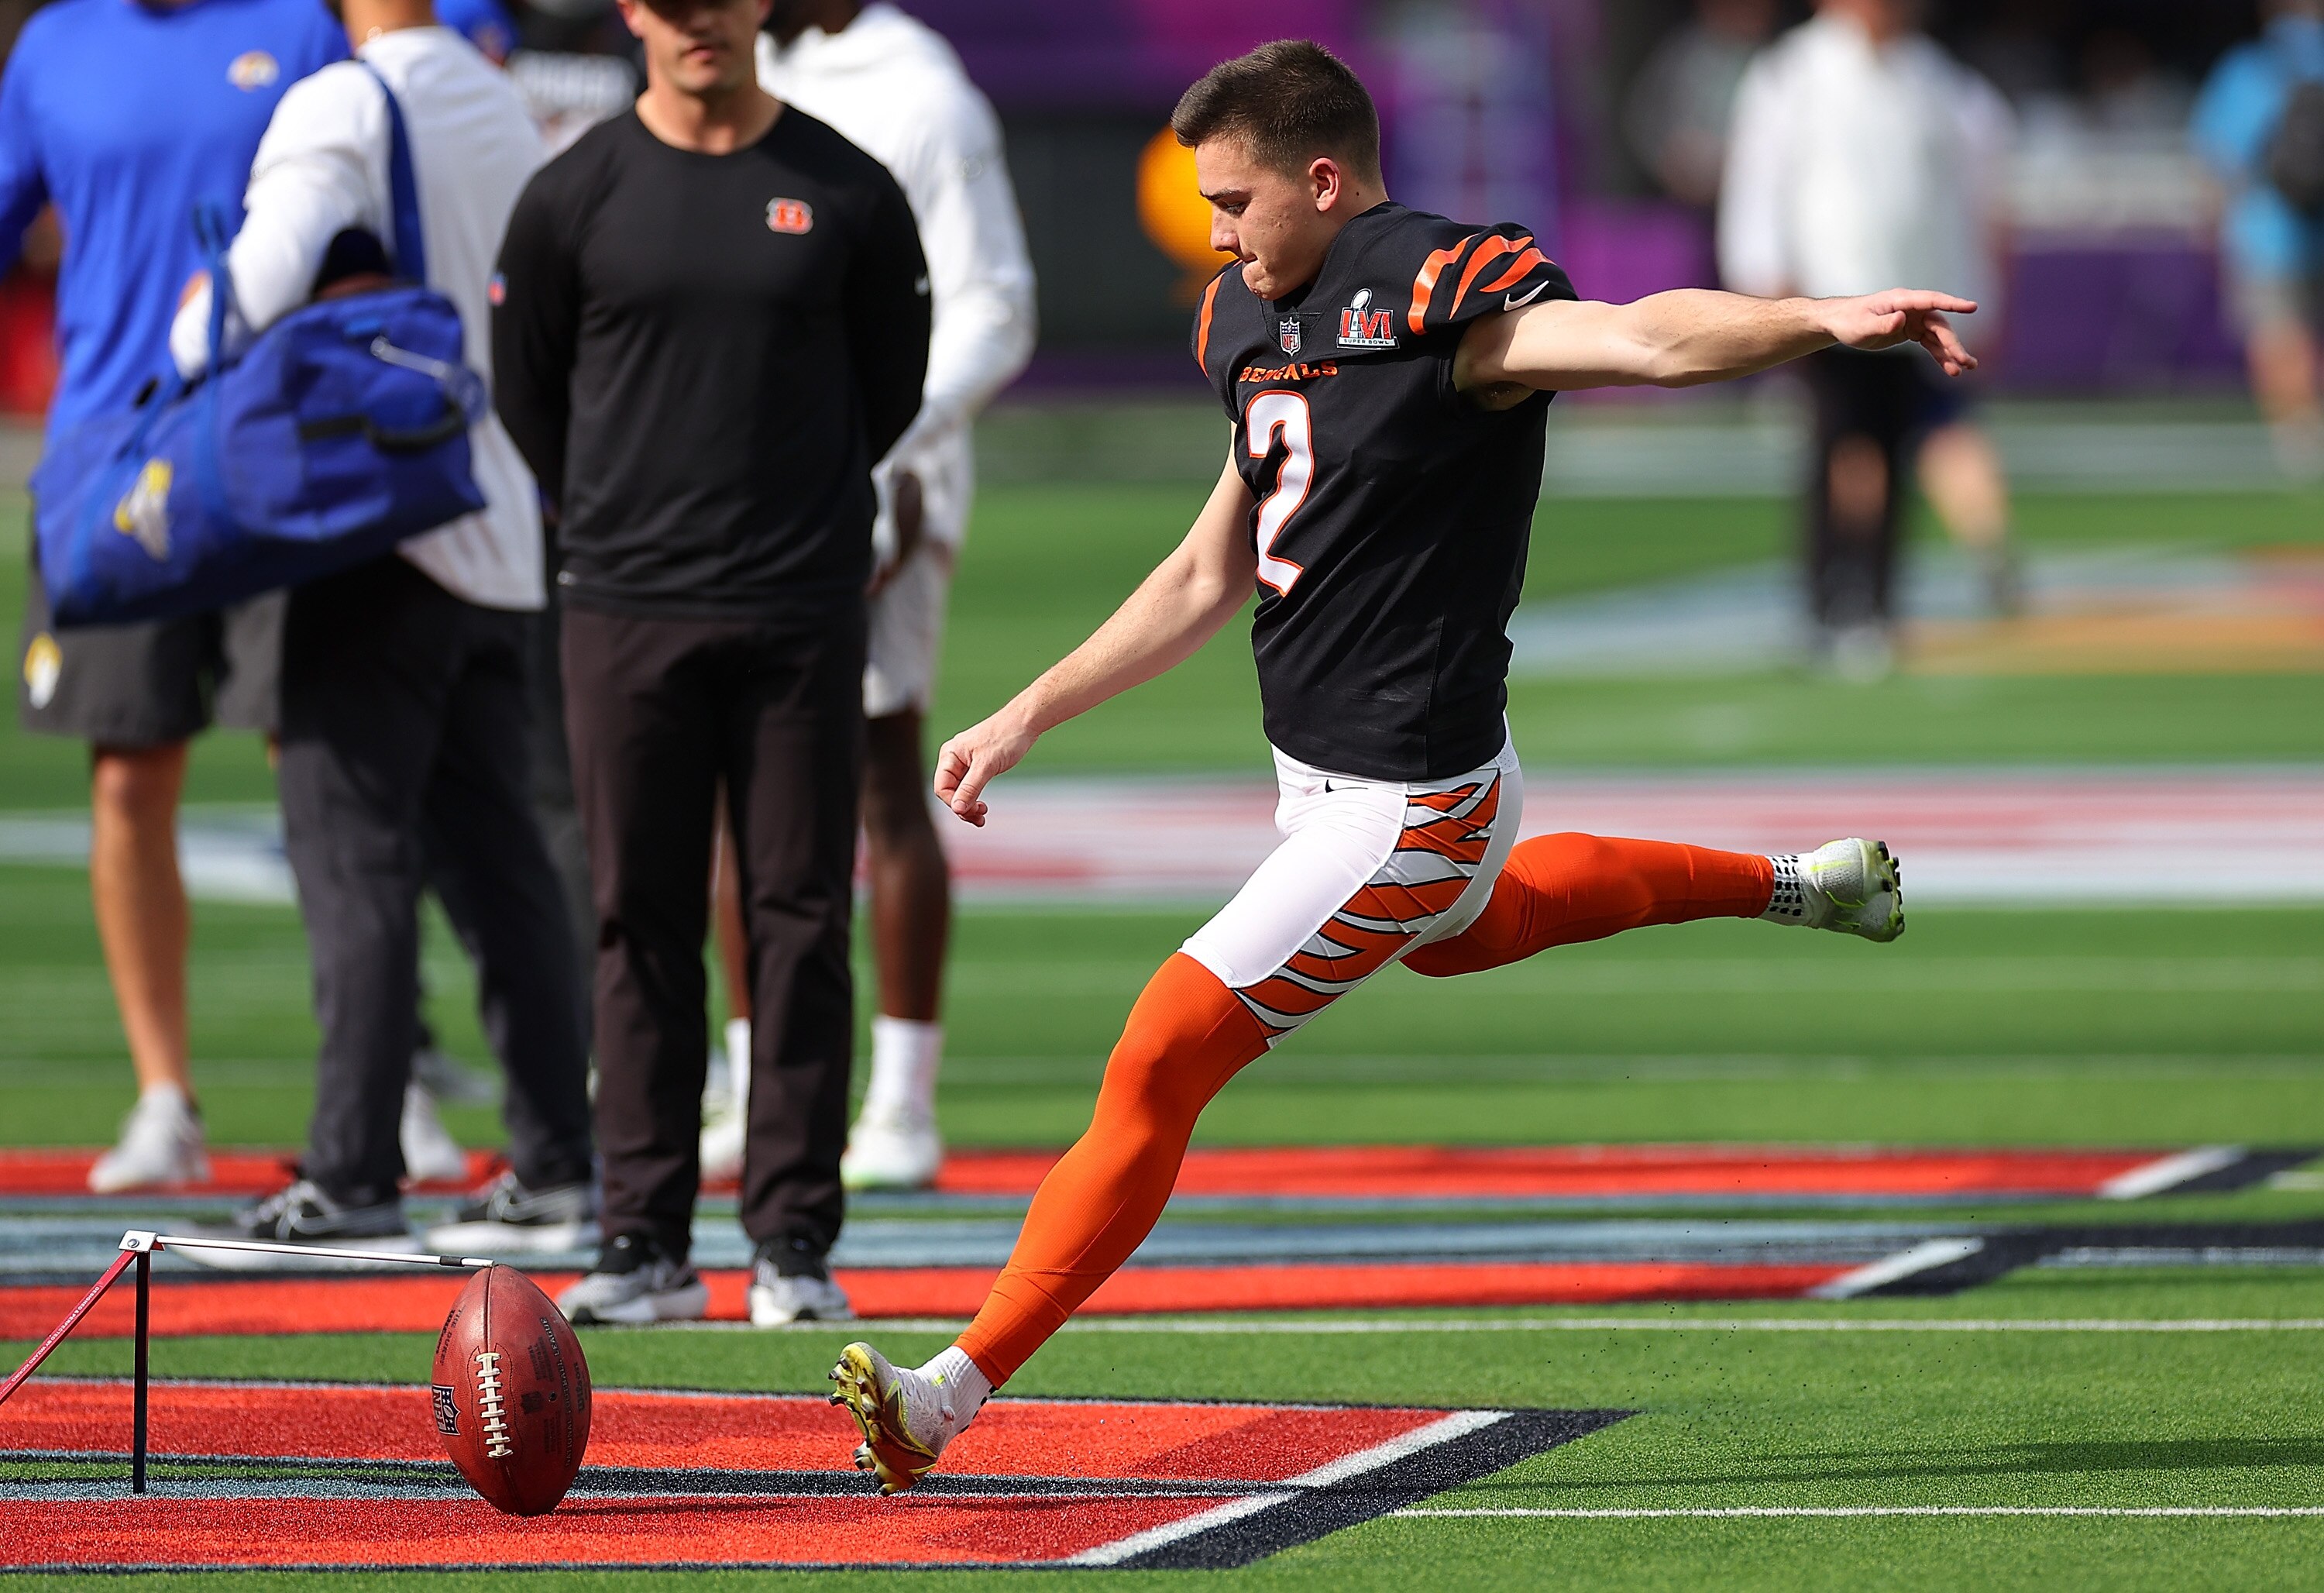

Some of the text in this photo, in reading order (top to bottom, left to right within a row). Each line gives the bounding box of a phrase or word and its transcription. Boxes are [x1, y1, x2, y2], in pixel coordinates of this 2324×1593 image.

[1341, 309, 1392, 339] LVI
[1282, 335, 1298, 348] NFL
[1239, 360, 1339, 383] BENGALS
[1245, 389, 1315, 598] 2
[77, 1286, 100, 1310] DESIGNED
[50, 1313, 77, 1341] PERFECTED
[540, 1317, 560, 1357] LEAGUE
[29, 1346, 46, 1364] WIZARD
[11, 1364, 30, 1382] KICKING
[557, 1359, 572, 1414] FOOTBALL
[432, 1391, 445, 1430] NFL
[564, 1419, 573, 1467] NATIONAL
